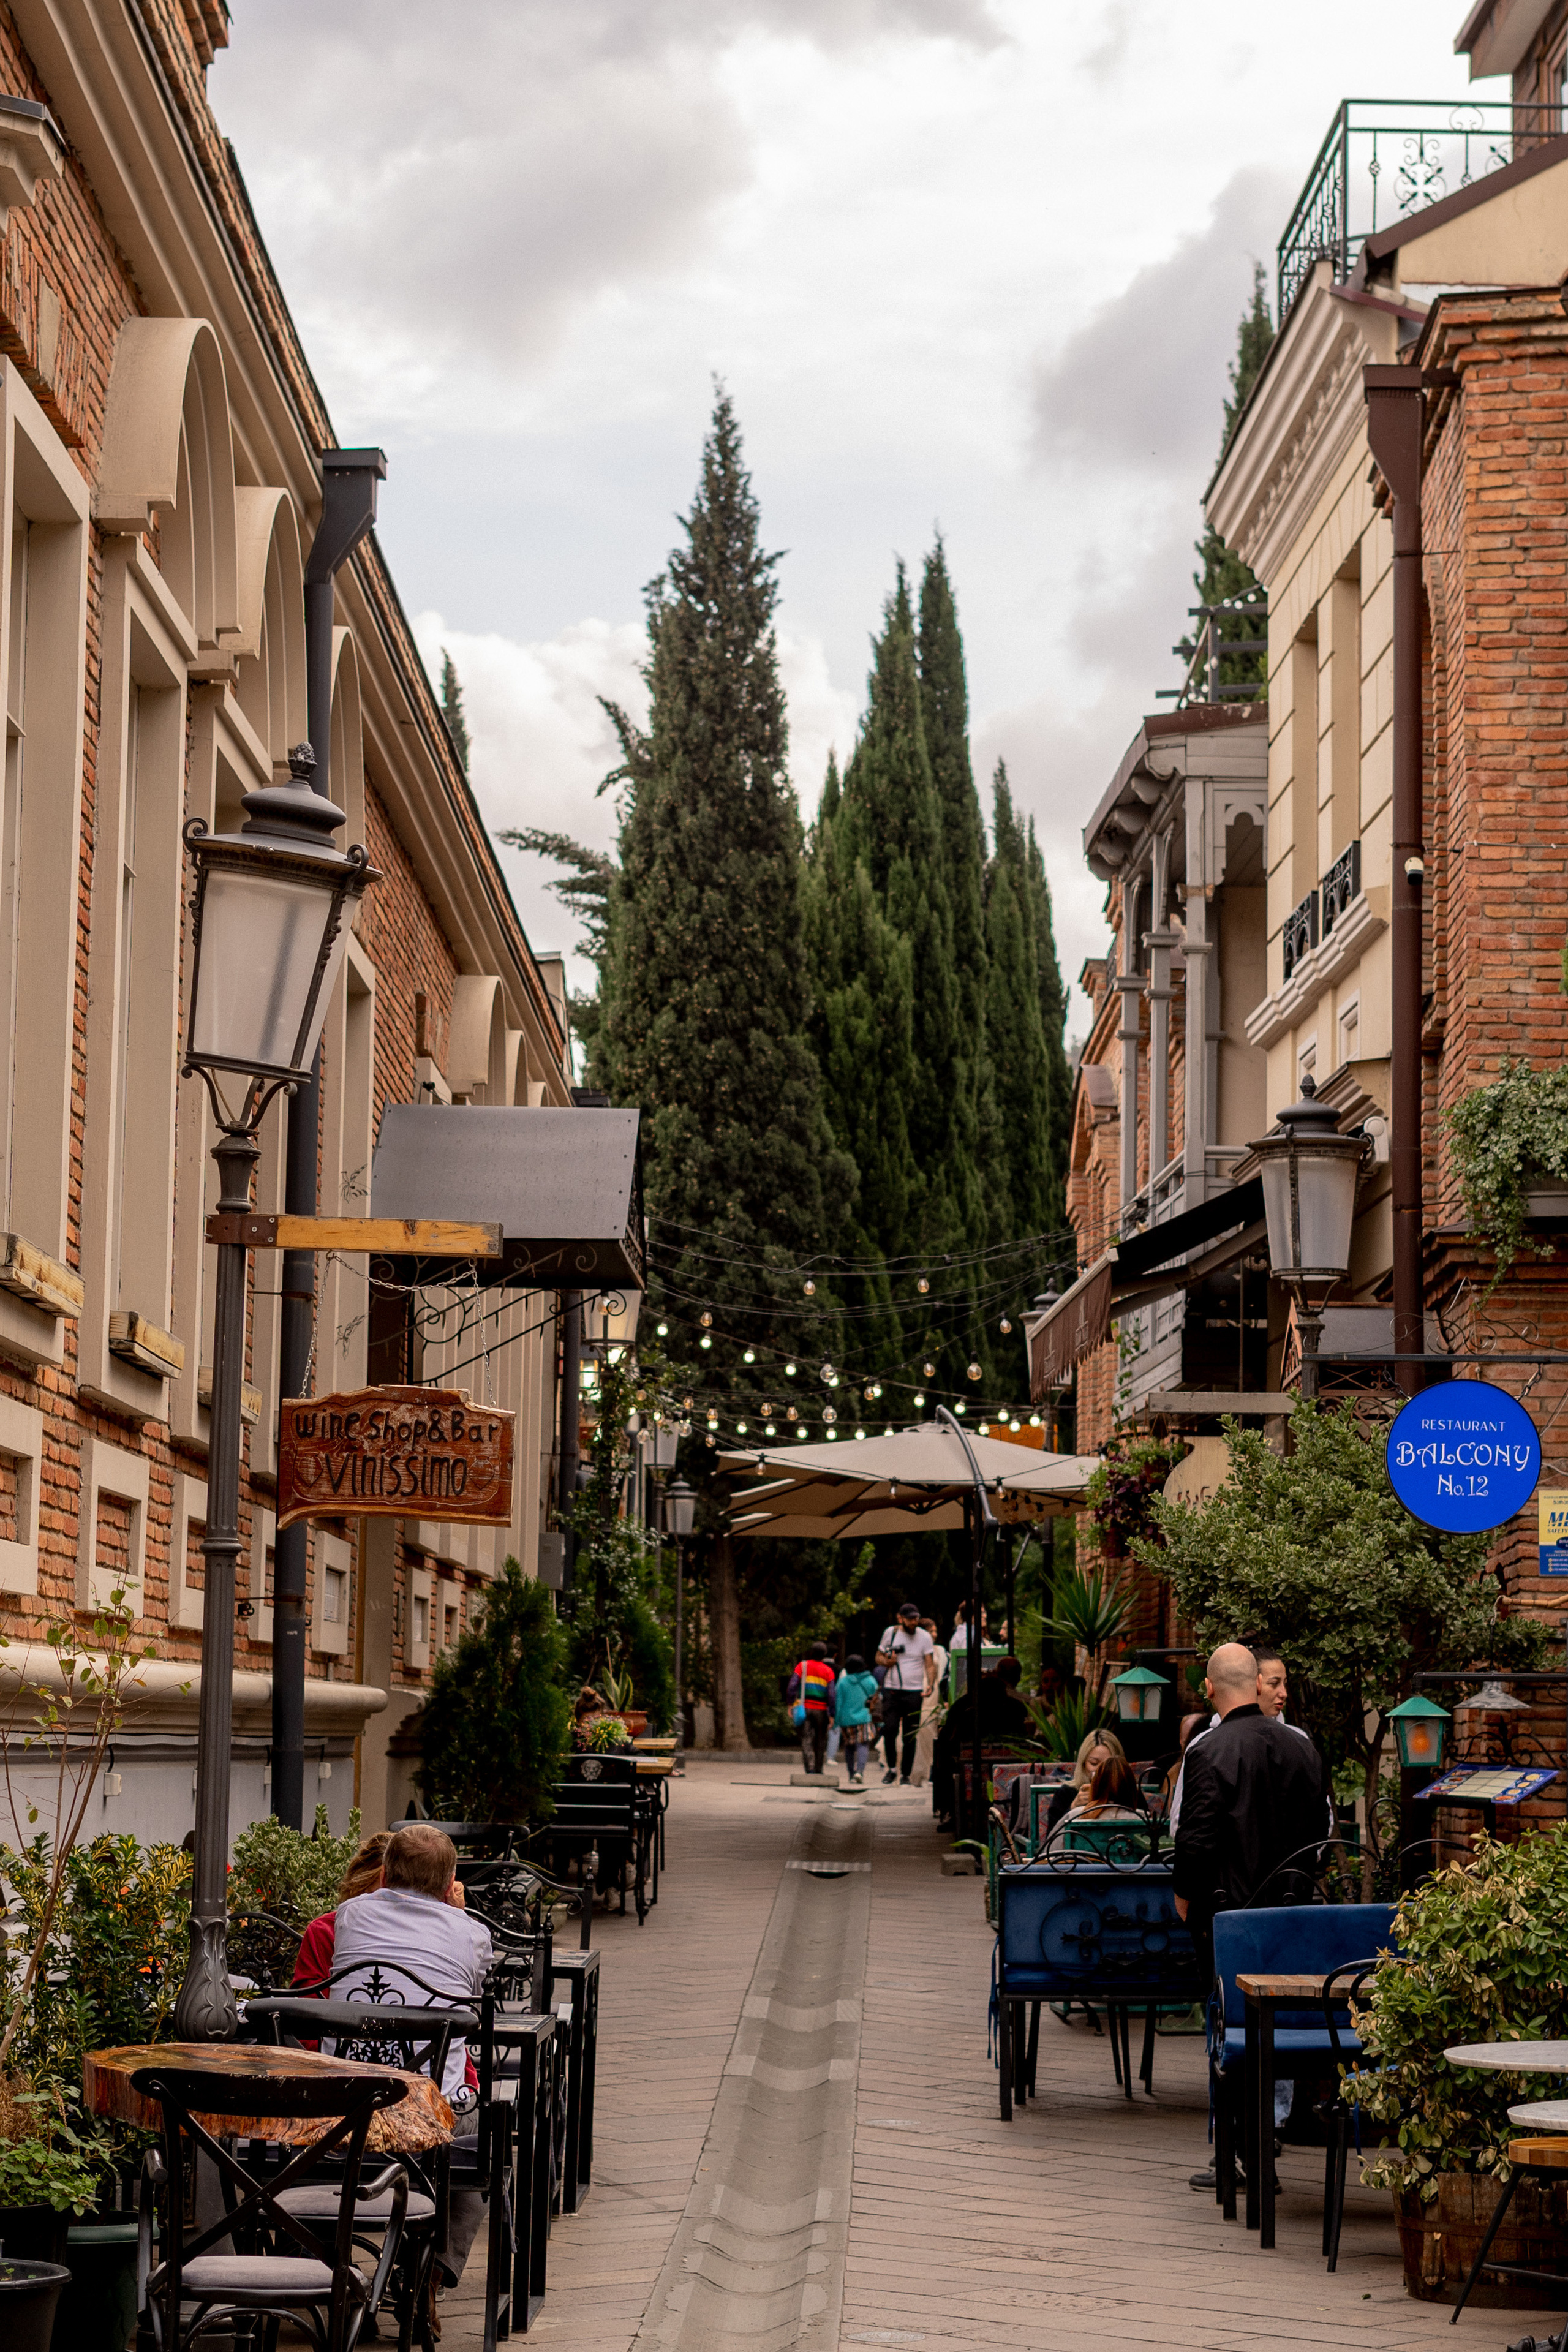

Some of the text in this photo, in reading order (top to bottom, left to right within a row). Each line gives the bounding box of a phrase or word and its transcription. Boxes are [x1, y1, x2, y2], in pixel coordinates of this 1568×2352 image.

[295, 1408, 361, 1440] wine
[1421, 1419, 1506, 1432] RESTAURANT
[1396, 1441, 1531, 1472] BALCONY
